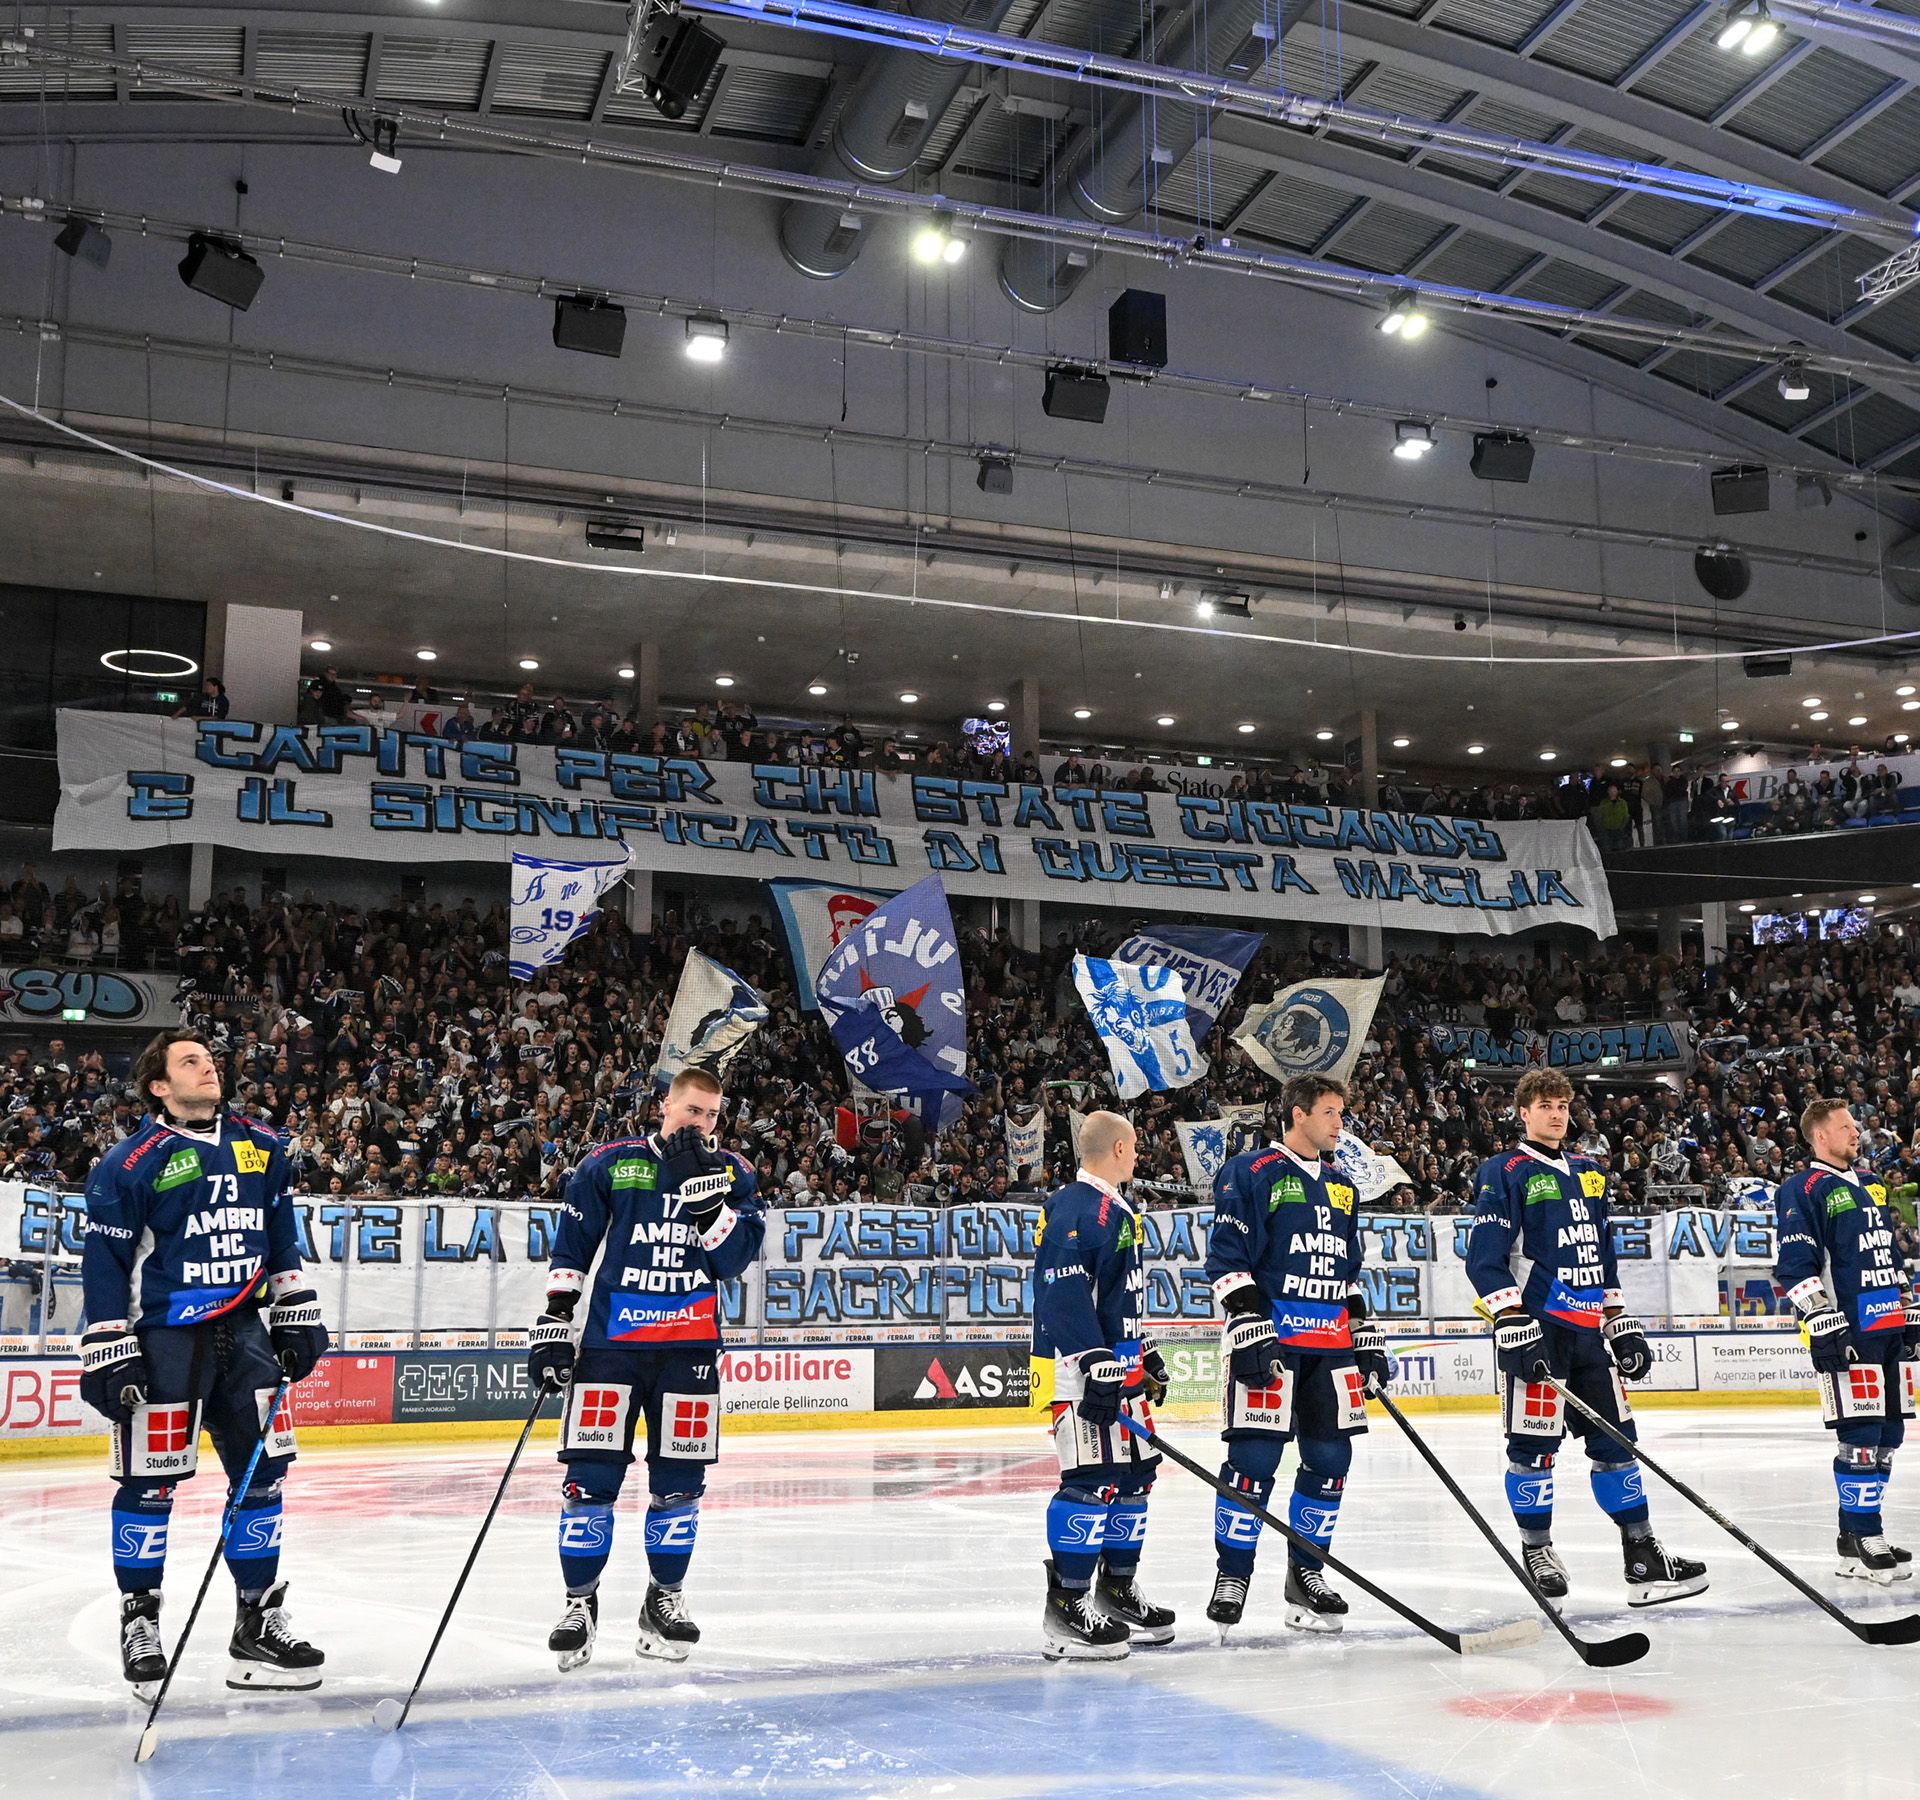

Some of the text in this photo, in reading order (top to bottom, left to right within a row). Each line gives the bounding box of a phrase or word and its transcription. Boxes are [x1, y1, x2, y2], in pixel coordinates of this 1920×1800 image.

[195, 720, 521, 785] CAPITE
[556, 746, 722, 804] PER
[752, 762, 880, 818] CHI
[913, 774, 1156, 838] STATE
[1167, 771, 1224, 799] Stato
[127, 770, 1584, 911] E IL SIGNIFICATO DI QUESTA MAGLIA
[541, 908, 574, 931] 19
[10, 968, 143, 1019] SUD
[845, 1037, 879, 1074] 88
[1169, 1030, 1191, 1076] 5
[207, 1174, 238, 1204] 73
[662, 1193, 683, 1218] 17
[184, 1207, 264, 1239] AMBRI
[1314, 1205, 1332, 1231] 12
[1862, 1207, 1884, 1228] 72
[424, 1205, 497, 1263] LA
[630, 1222, 701, 1247] AMBR
[209, 1233, 245, 1258] HC
[1289, 1233, 1348, 1259] AMBRI
[1576, 1244, 1599, 1265] HC
[652, 1246, 684, 1269] HC
[1310, 1255, 1336, 1276] HC
[1873, 1248, 1893, 1267] HC
[621, 1266, 711, 1292] PIOTTA
[1282, 1274, 1347, 1300] PIOTTA
[765, 1265, 1034, 1322] SACRIFICI
[529, 1327, 568, 1342] RRIOR
[1453, 1354, 1473, 1366] dal
[1712, 1346, 1809, 1357] Team Personne
[719, 1352, 851, 1382] Mobiliare
[1454, 1369, 1484, 1381] 1947
[1714, 1370, 1756, 1383] Agenzia
[1759, 1372, 1777, 1383] per
[1780, 1369, 1786, 1380] il
[295, 1389, 314, 1398] luci
[296, 1379, 330, 1388] cucine
[487, 1390, 526, 1399] TUTTA
[295, 1398, 376, 1411] proget. d'interni
[726, 1395, 849, 1413] generale Bellinzona
[1853, 1402, 1875, 1412] Studio
[1245, 1412, 1272, 1424] Studio
[1523, 1419, 1548, 1430] Studio
[577, 1432, 605, 1442] Studio
[671, 1442, 699, 1452] Studio
[146, 1457, 180, 1469] Studio
